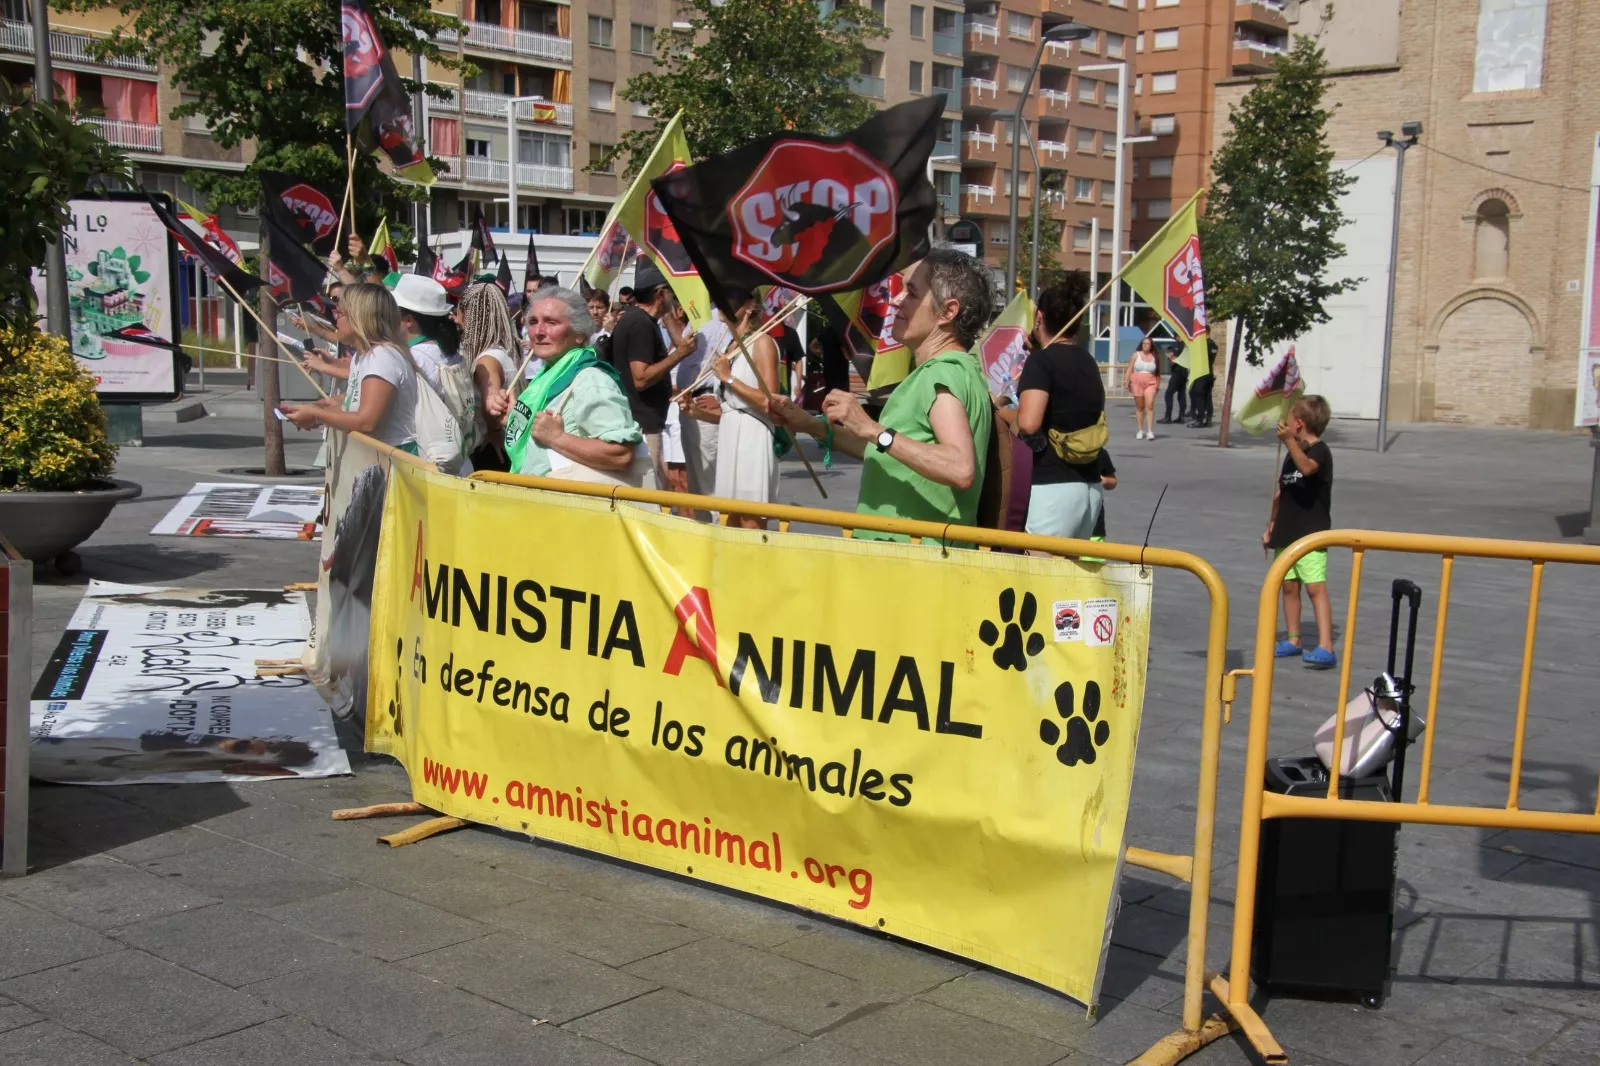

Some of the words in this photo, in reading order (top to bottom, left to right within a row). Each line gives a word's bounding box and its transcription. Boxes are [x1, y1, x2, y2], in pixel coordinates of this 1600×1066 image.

[741, 178, 891, 262] STOP
[409, 519, 646, 668] AMNISTIA
[661, 585, 984, 739] ANIMAL
[412, 635, 427, 684] En
[440, 651, 570, 723] defensa
[588, 688, 631, 738] de
[651, 700, 706, 757] los
[724, 733, 914, 807] animales
[423, 756, 874, 909] www.amnistiaanimal.org
